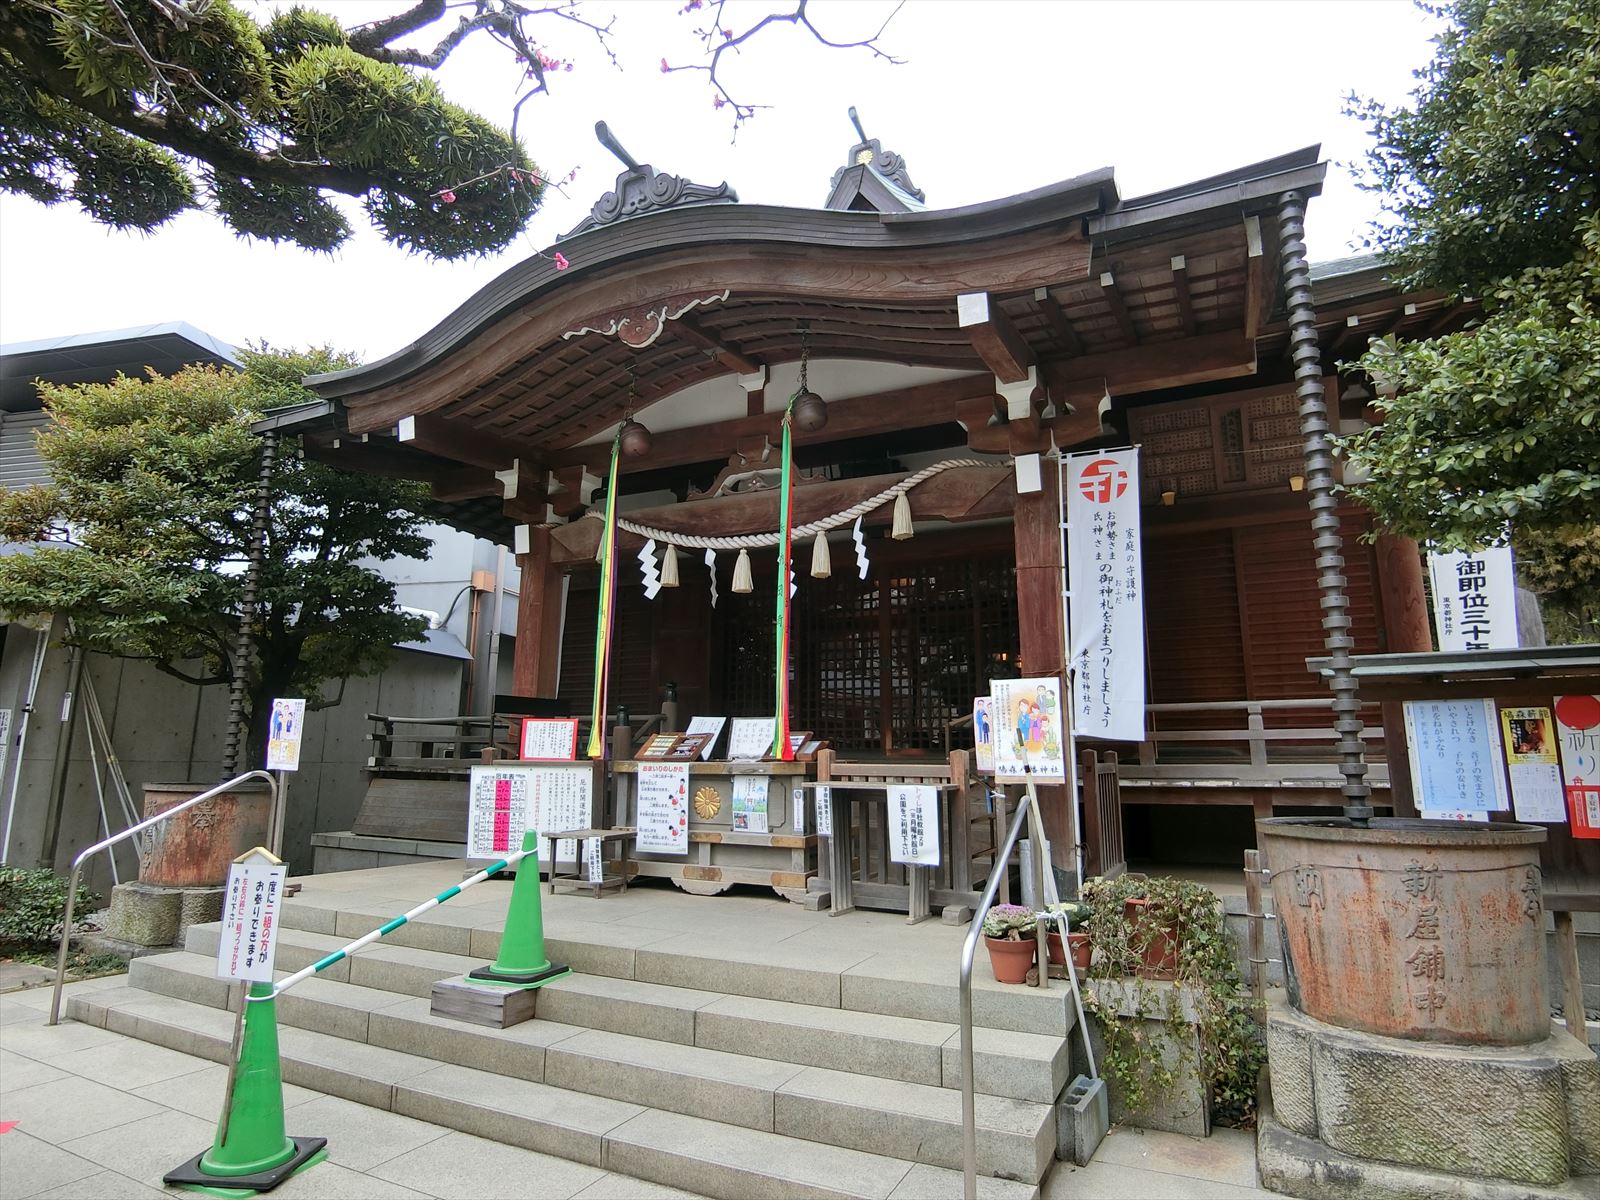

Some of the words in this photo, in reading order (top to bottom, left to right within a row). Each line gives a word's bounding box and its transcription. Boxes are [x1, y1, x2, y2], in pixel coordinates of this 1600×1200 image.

[1093, 511, 1104, 561] 氏神さま
[1106, 511, 1117, 560] お伊勢さま
[1125, 527, 1137, 601] 家庭の守護神
[1099, 563, 1114, 728] の御神札をおまつりしましょう
[1081, 648, 1092, 716] 東京都神社庁
[228, 877, 240, 929] お参り下さい
[245, 880, 264, 969] お参りできます
[259, 872, 279, 963] 一度に二組の方が
